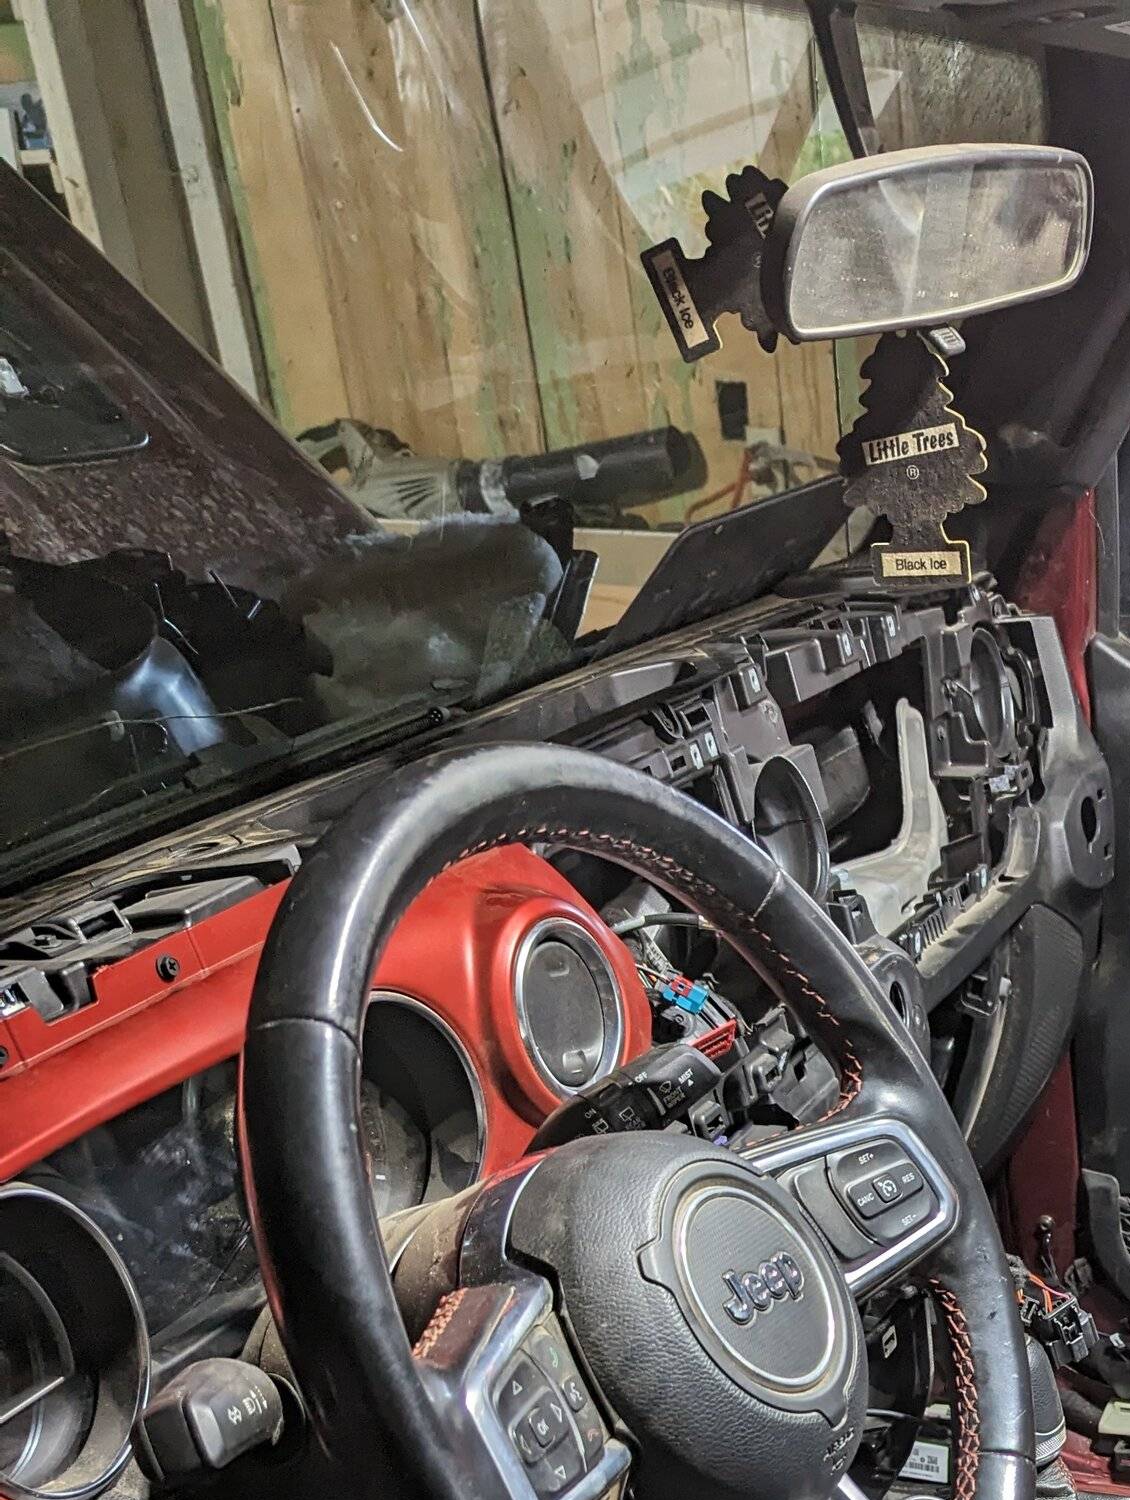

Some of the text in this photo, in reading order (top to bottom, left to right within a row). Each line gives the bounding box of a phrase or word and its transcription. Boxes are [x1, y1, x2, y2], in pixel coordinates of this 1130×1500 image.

[679, 307, 695, 330] Ice
[868, 430, 955, 463] Little Trees
[895, 558, 947, 571] Black Ice
[634, 1072, 649, 1083] OFF
[678, 1069, 693, 1084] MIST
[901, 1172, 916, 1185] RES
[857, 1192, 875, 1207] CANC
[722, 1251, 803, 1325] Jeep
